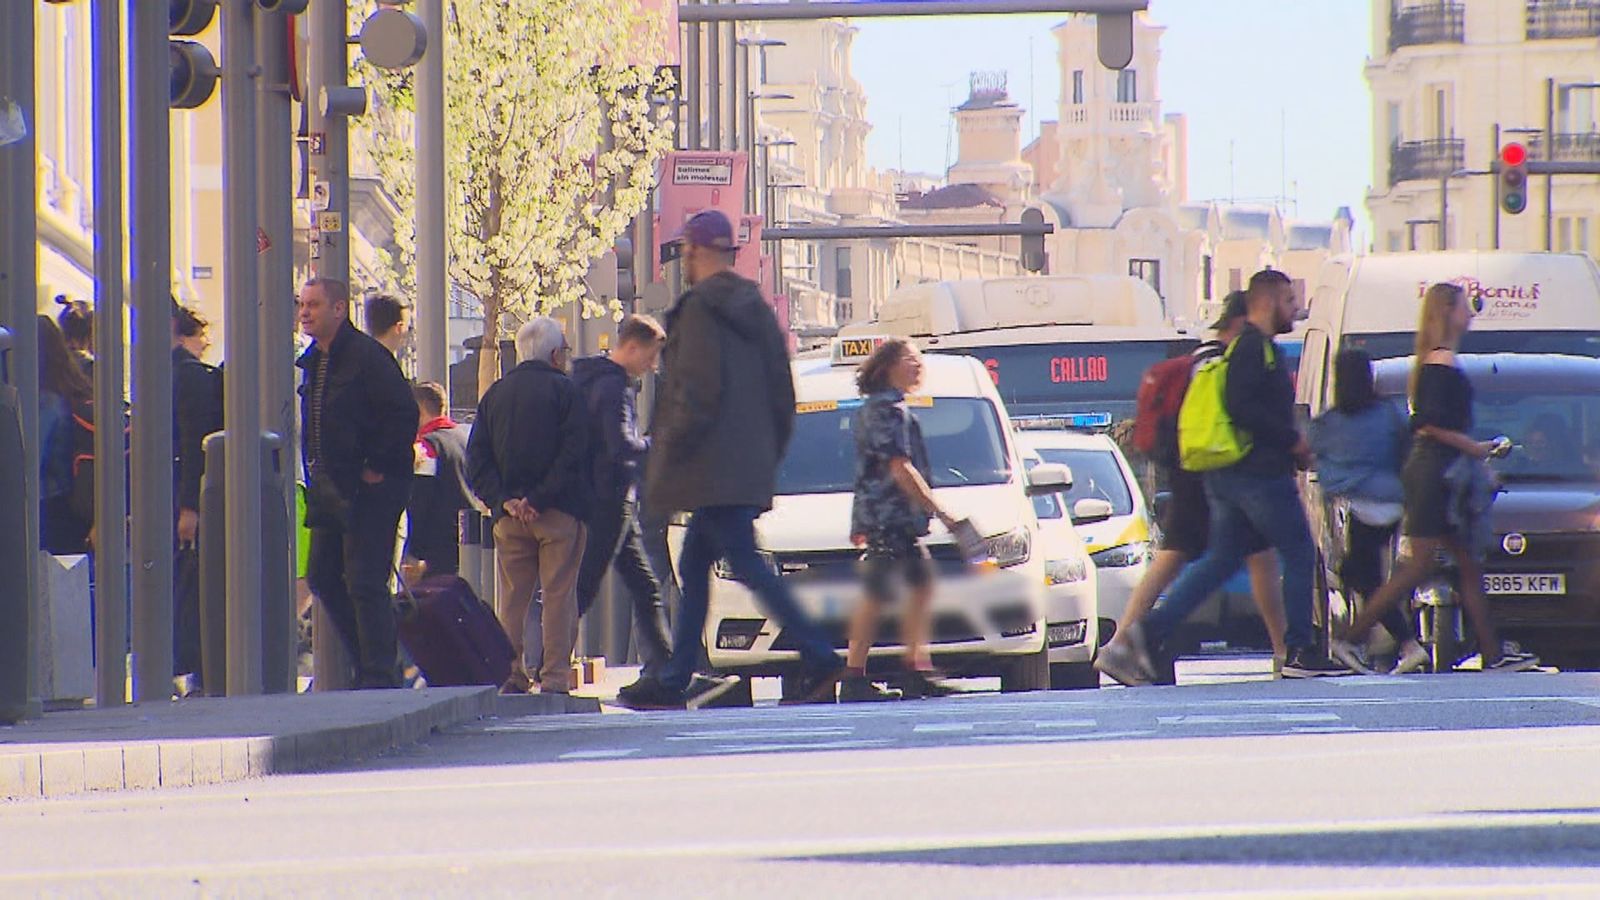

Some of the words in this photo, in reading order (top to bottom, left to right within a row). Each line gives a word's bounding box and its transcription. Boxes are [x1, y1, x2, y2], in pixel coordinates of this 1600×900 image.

[690, 174, 728, 182] molestar
[843, 340, 873, 356] TAXI
[1050, 356, 1108, 383] CALLAO
